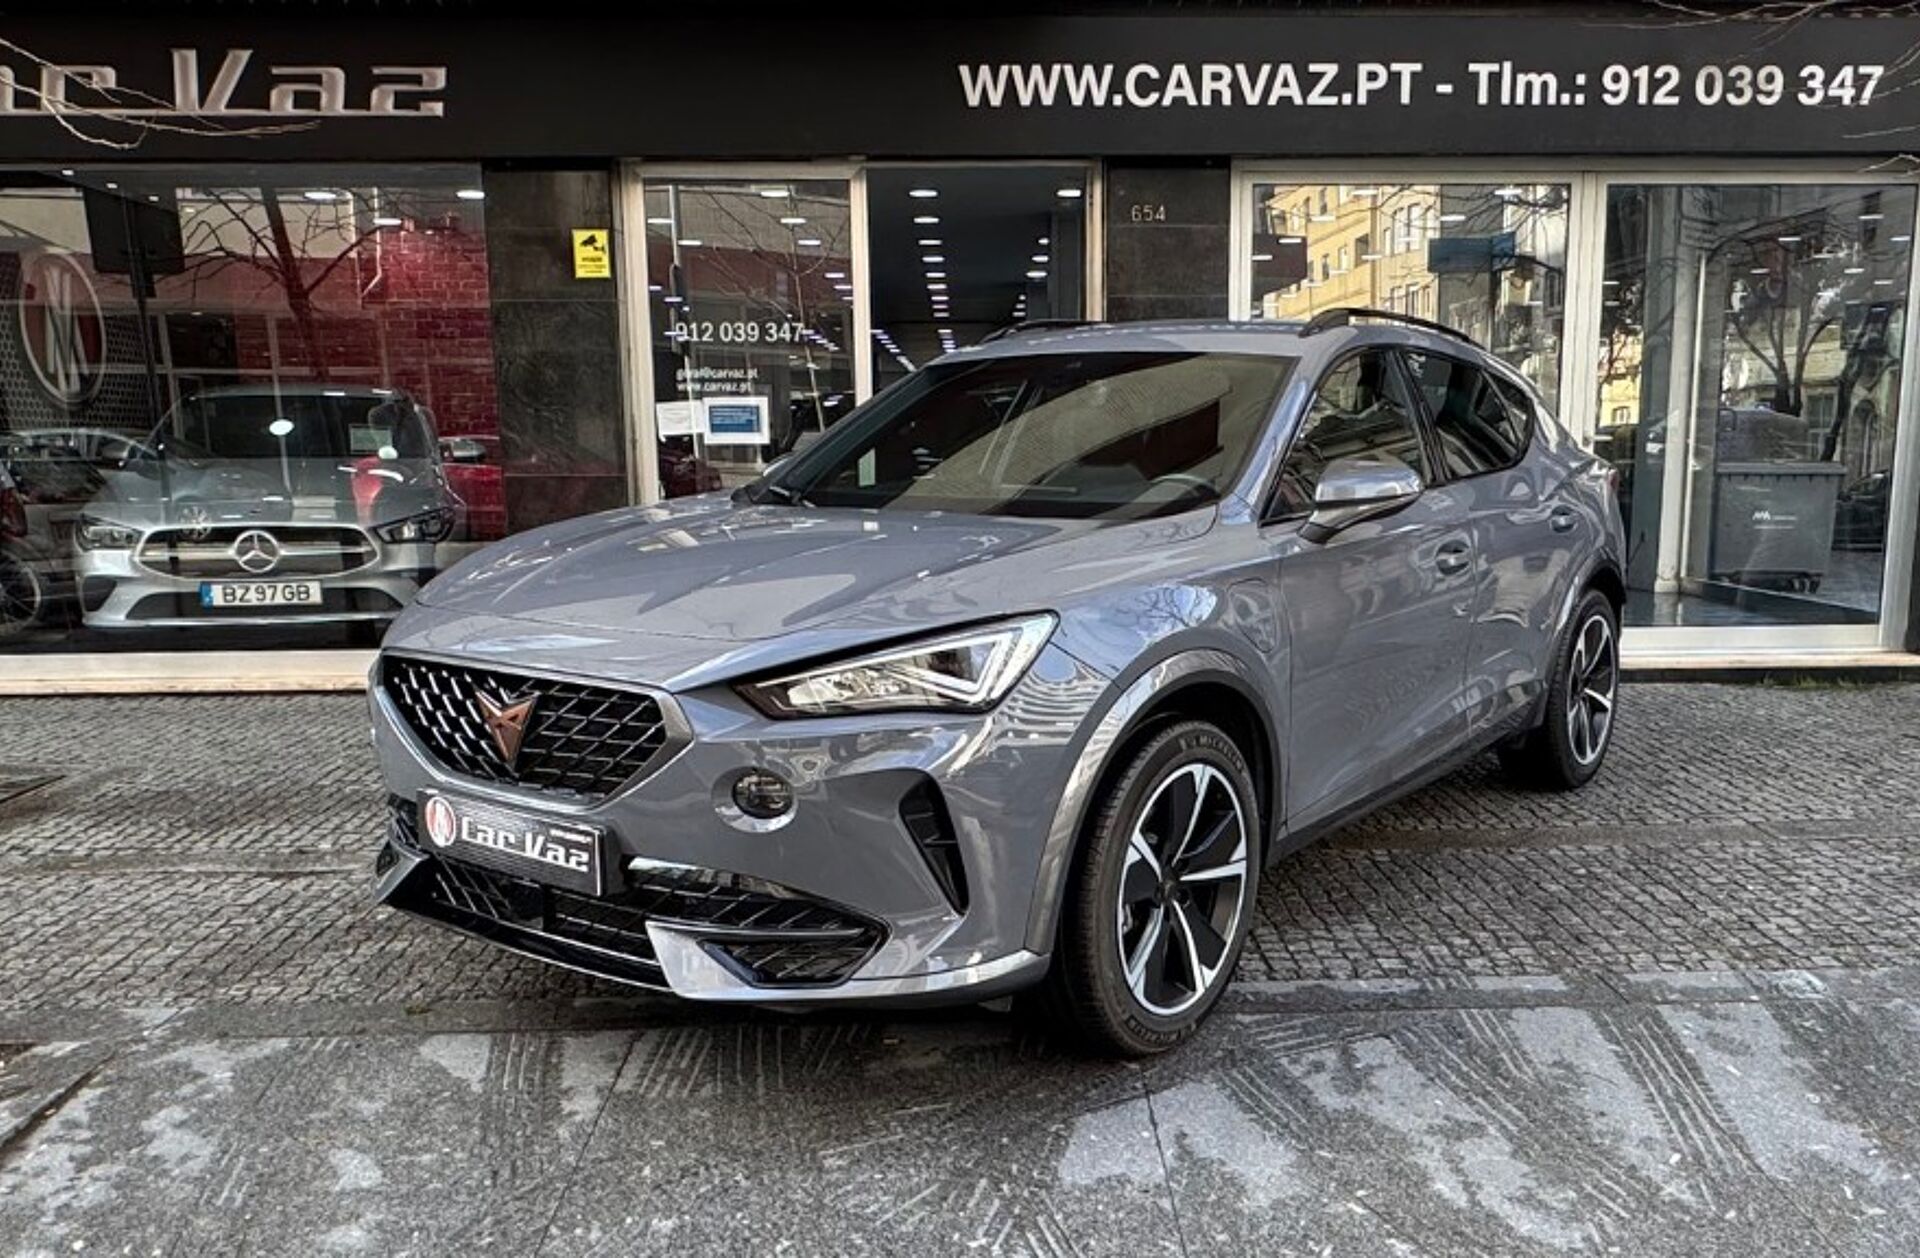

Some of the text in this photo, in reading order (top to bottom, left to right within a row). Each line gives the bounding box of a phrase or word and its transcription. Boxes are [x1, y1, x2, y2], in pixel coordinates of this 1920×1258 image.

[170, 48, 447, 117] Vaz
[958, 63, 1423, 107] WWW.CARVAZ.PT
[1468, 61, 1587, 106] Tlm.:
[1600, 64, 1681, 107] 912
[1695, 64, 1785, 107] 039
[1797, 64, 1885, 107] 347
[1132, 204, 1166, 222] 654
[675, 321, 804, 342] 912 039 347
[222, 584, 311, 603] BZ 97 GB
[461, 816, 516, 851] Car
